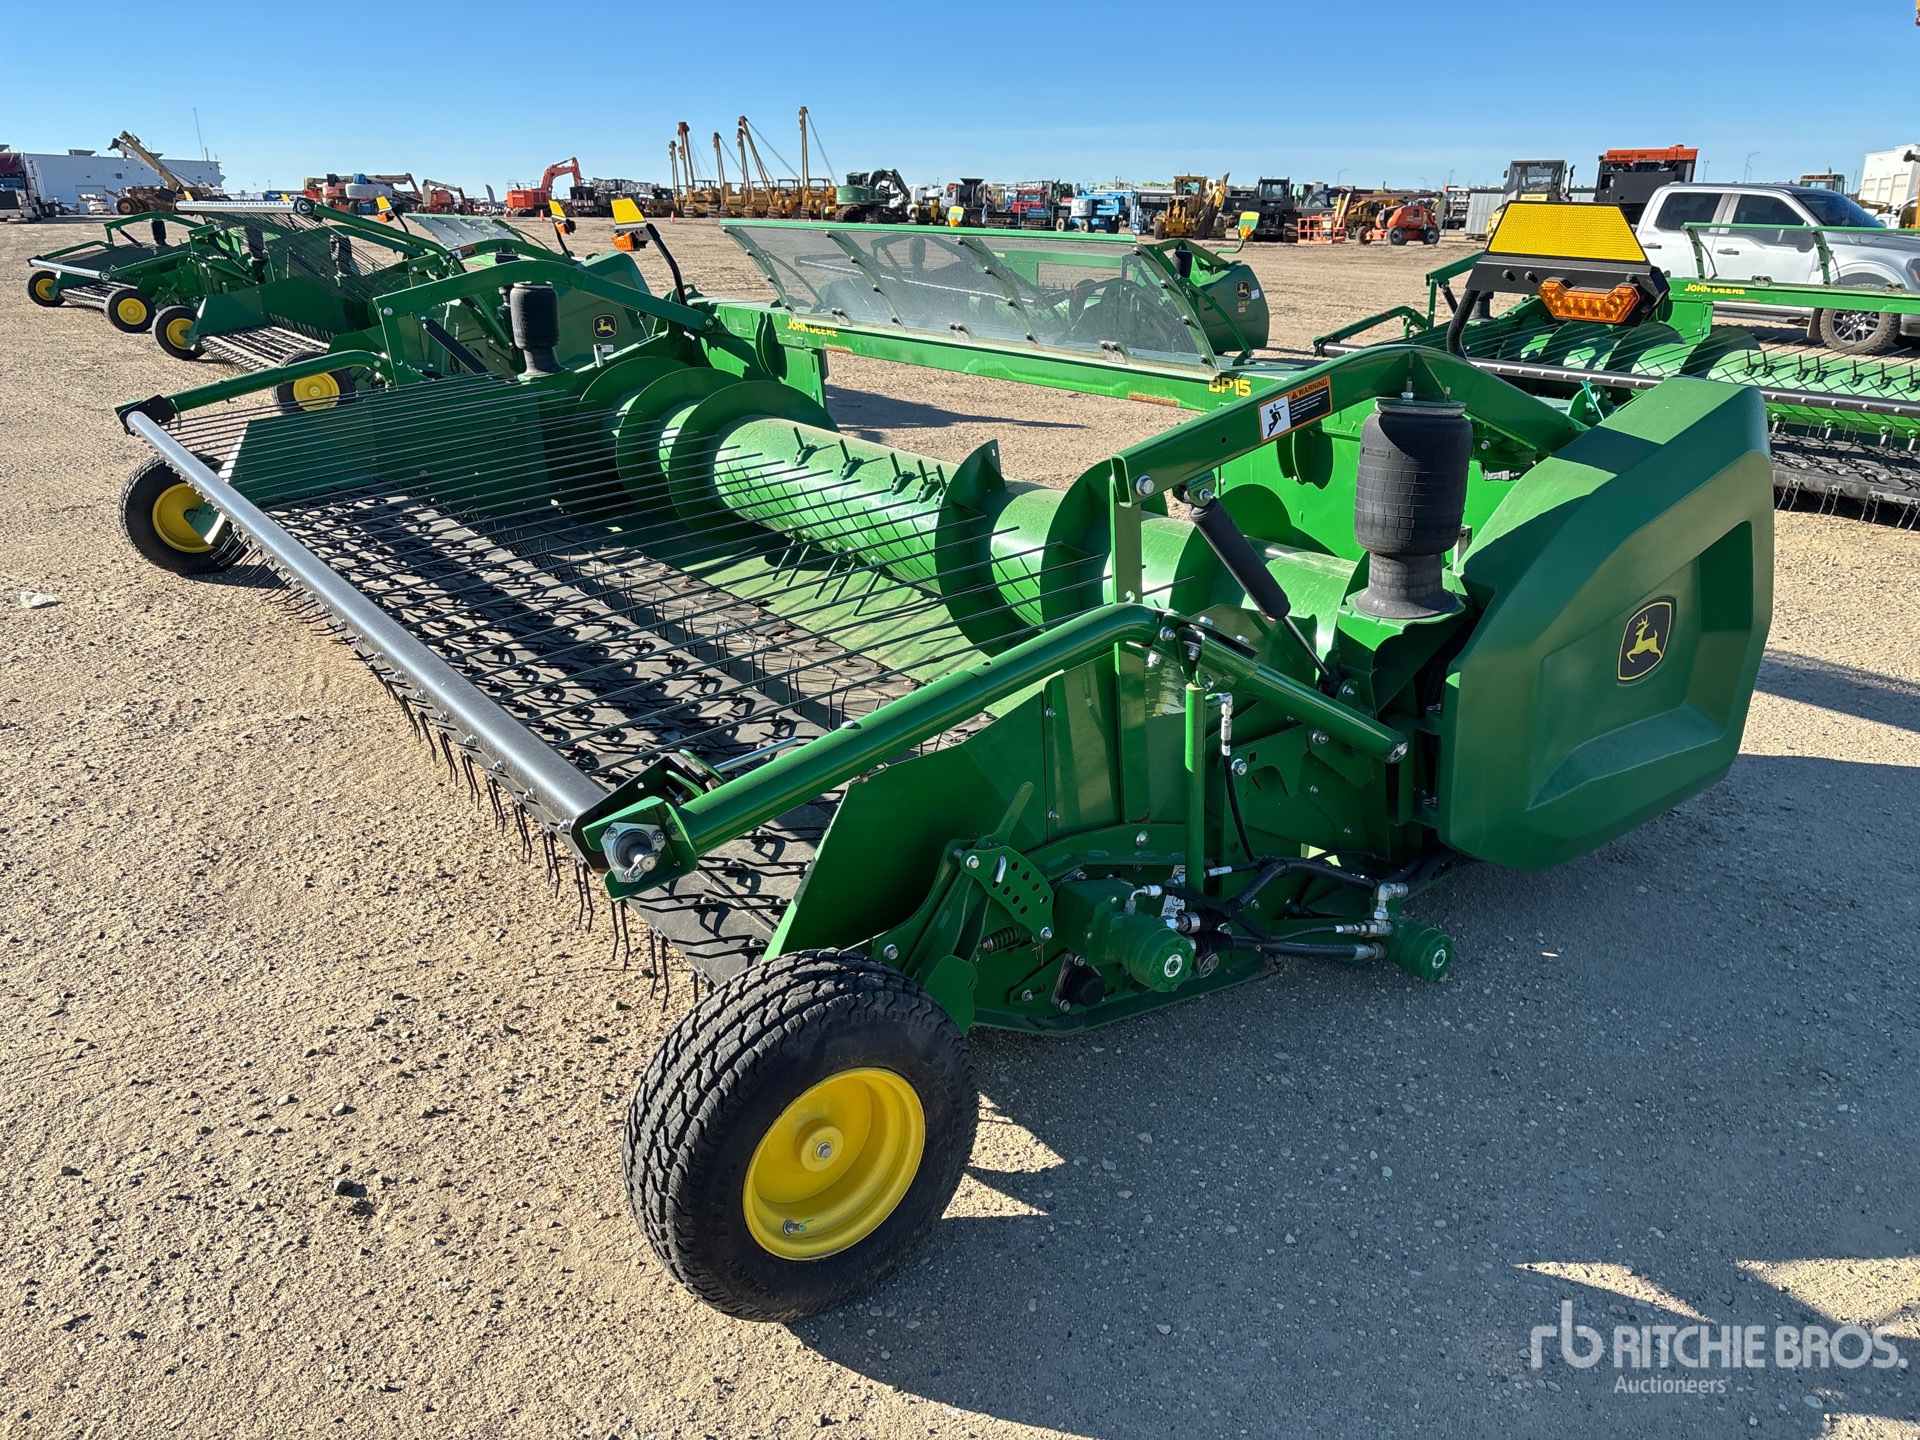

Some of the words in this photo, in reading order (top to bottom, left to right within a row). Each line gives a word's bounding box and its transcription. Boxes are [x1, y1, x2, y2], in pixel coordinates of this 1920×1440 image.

[1684, 283, 1711, 293] JOHN
[1712, 286, 1746, 295] DEERE
[787, 317, 809, 333] JOHN
[809, 324, 838, 338] DEERE
[1208, 375, 1252, 397] BP15
[1297, 378, 1328, 396] WARNING
